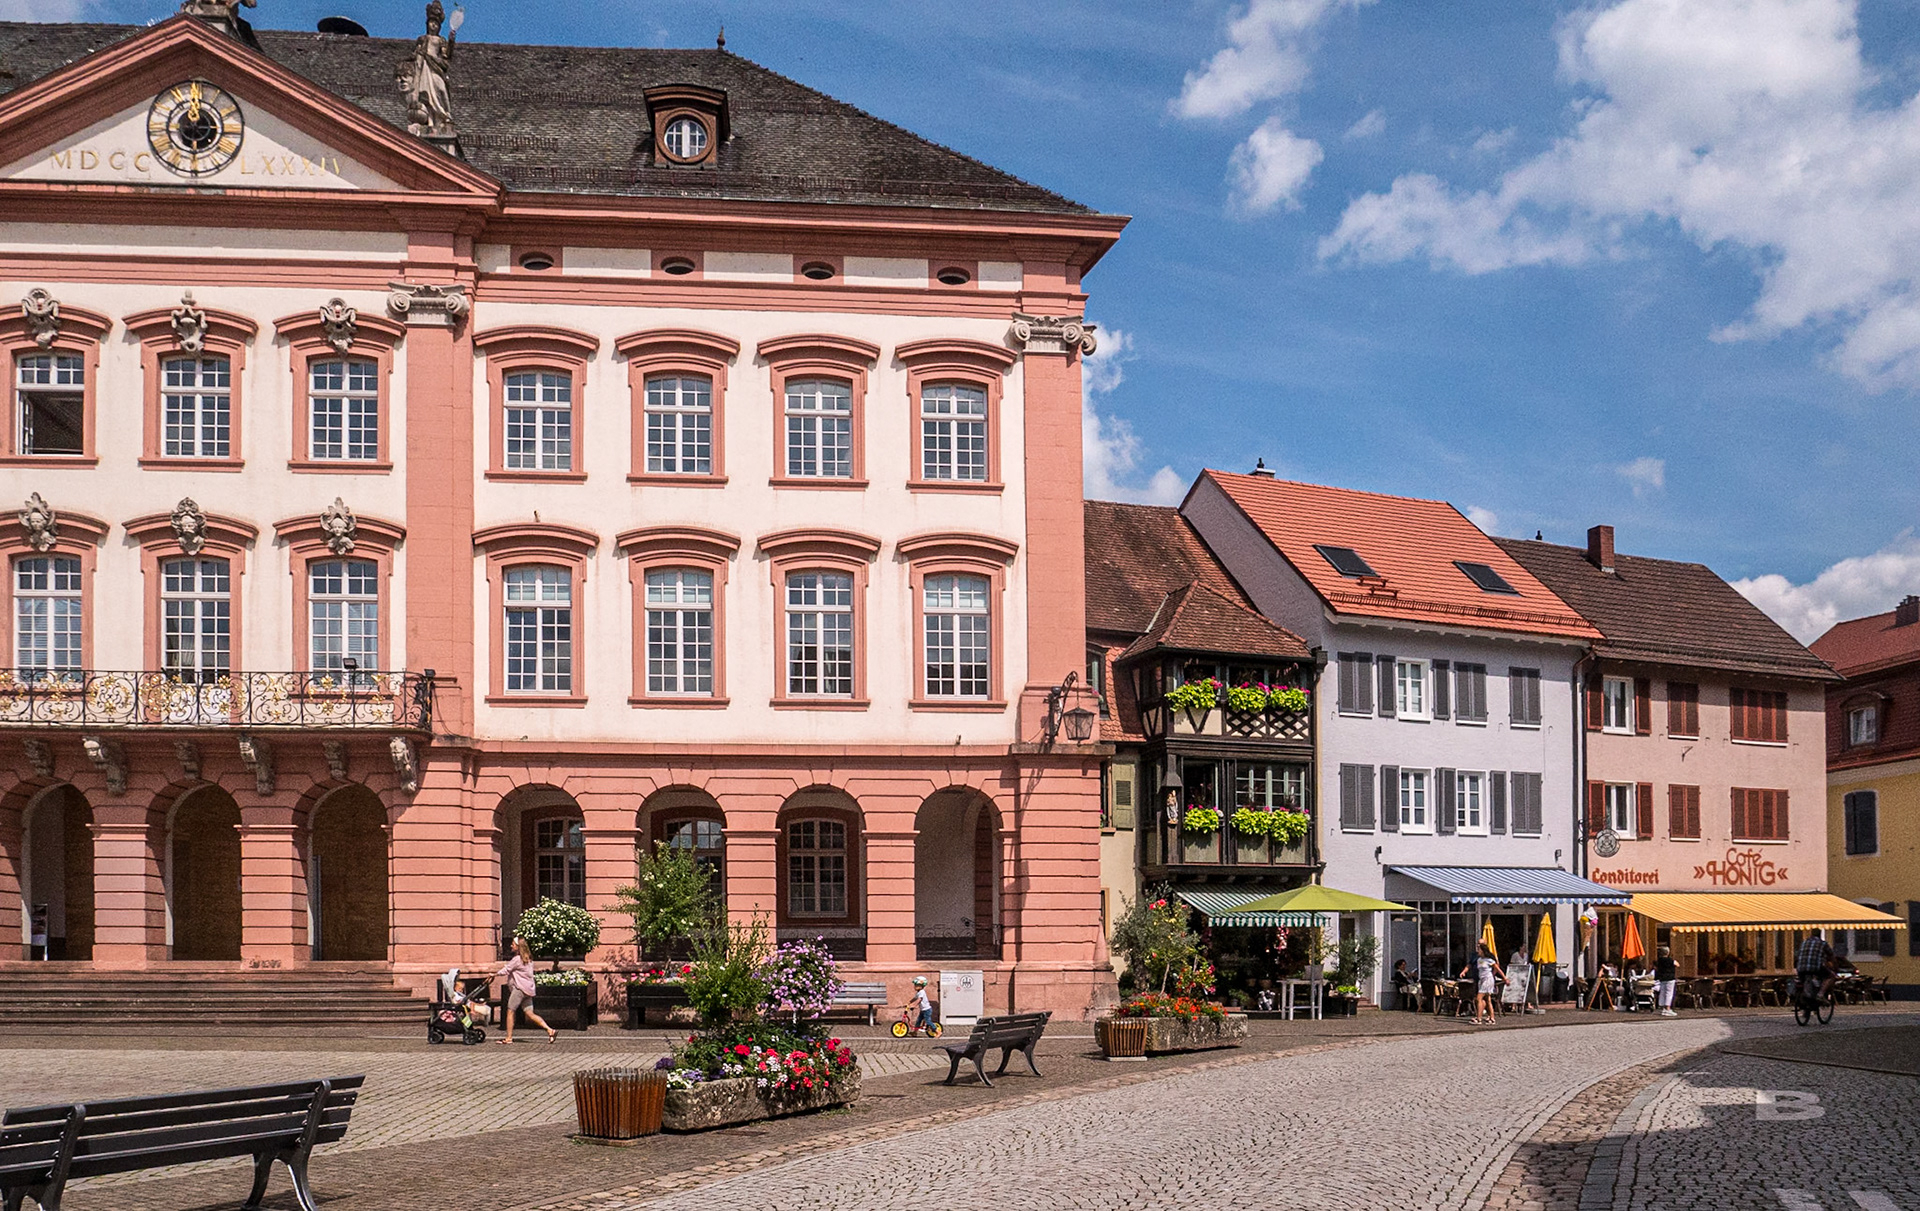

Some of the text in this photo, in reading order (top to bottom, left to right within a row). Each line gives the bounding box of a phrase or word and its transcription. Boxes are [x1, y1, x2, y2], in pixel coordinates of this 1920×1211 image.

[51, 149, 150, 172] MDCC
[1726, 847, 1763, 867] Café
[1592, 867, 1659, 885] Conditorei
